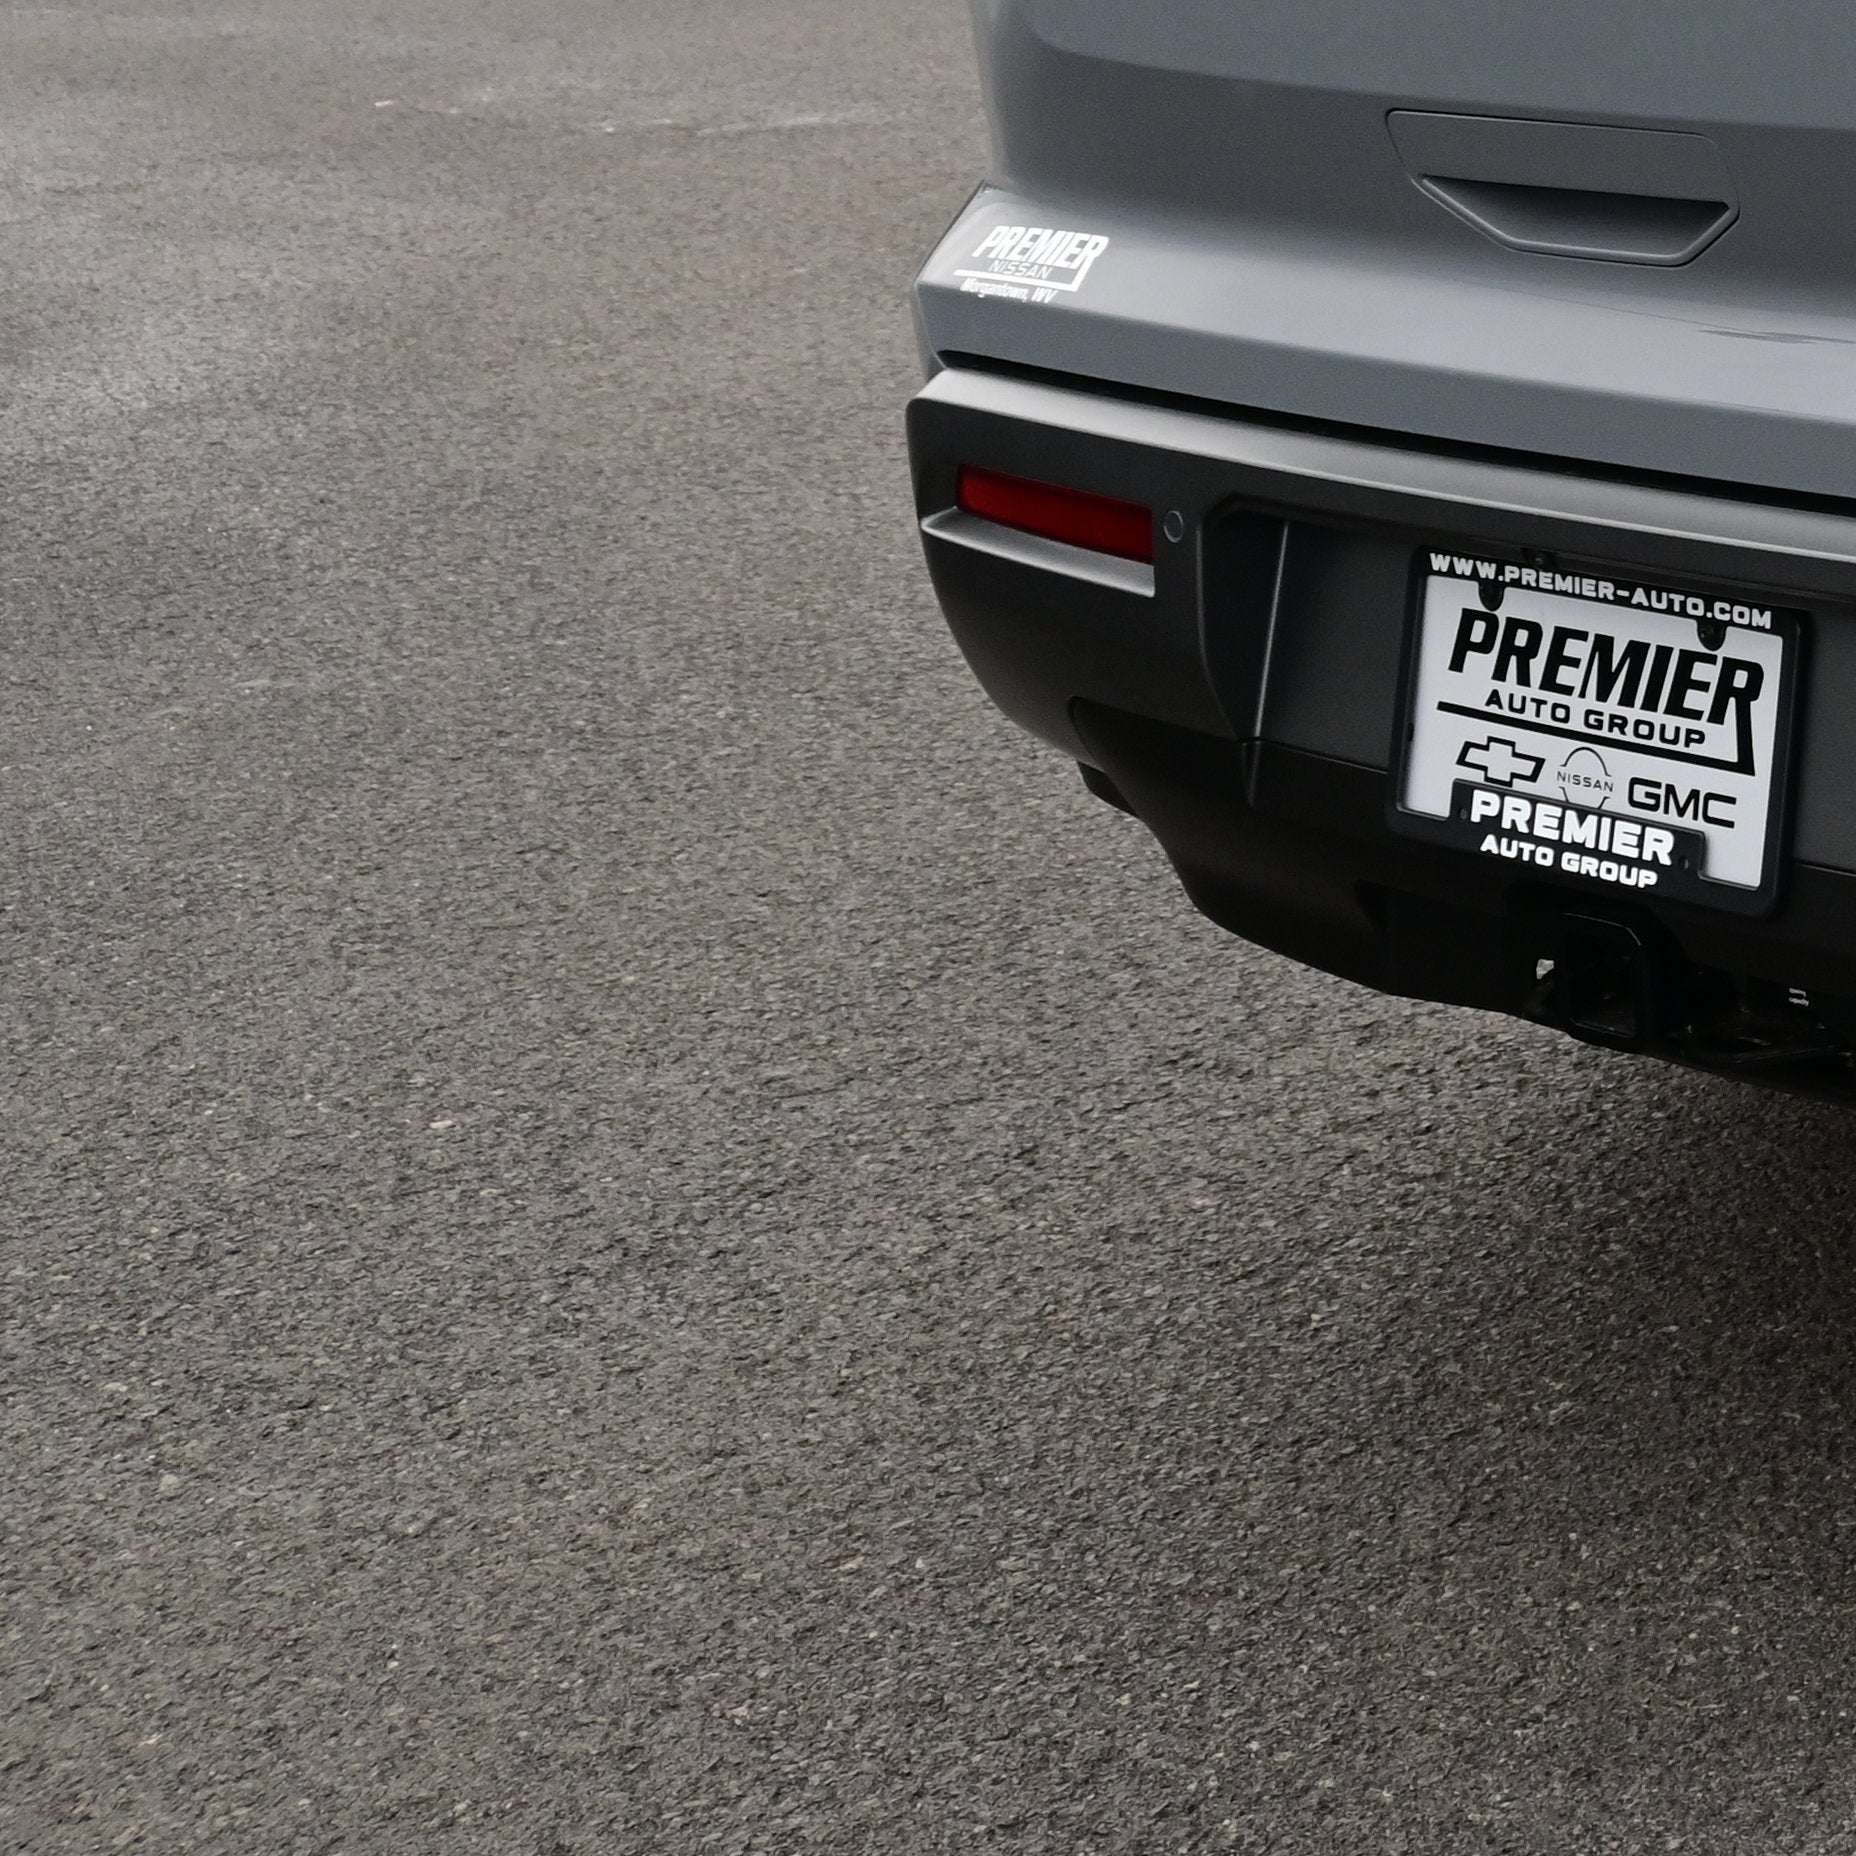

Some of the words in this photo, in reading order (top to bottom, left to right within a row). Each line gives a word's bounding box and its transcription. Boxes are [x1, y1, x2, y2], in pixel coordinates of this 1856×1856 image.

[971, 225, 1109, 270] PREMIER
[988, 259, 1054, 279] NISSAN
[1031, 287, 1059, 304] WV
[1429, 552, 1773, 630] WWW.PREMIER-AUTO.COM
[1447, 607, 1765, 728] PREMIER
[1484, 688, 1572, 725] AUTO
[1583, 710, 1707, 749] GROUP
[1556, 770, 1614, 793] NISSAN
[1627, 776, 1738, 829] GMC
[1469, 789, 1675, 866] PREMIER
[1479, 832, 1555, 867] AUTO
[1560, 852, 1659, 889] GROUP
